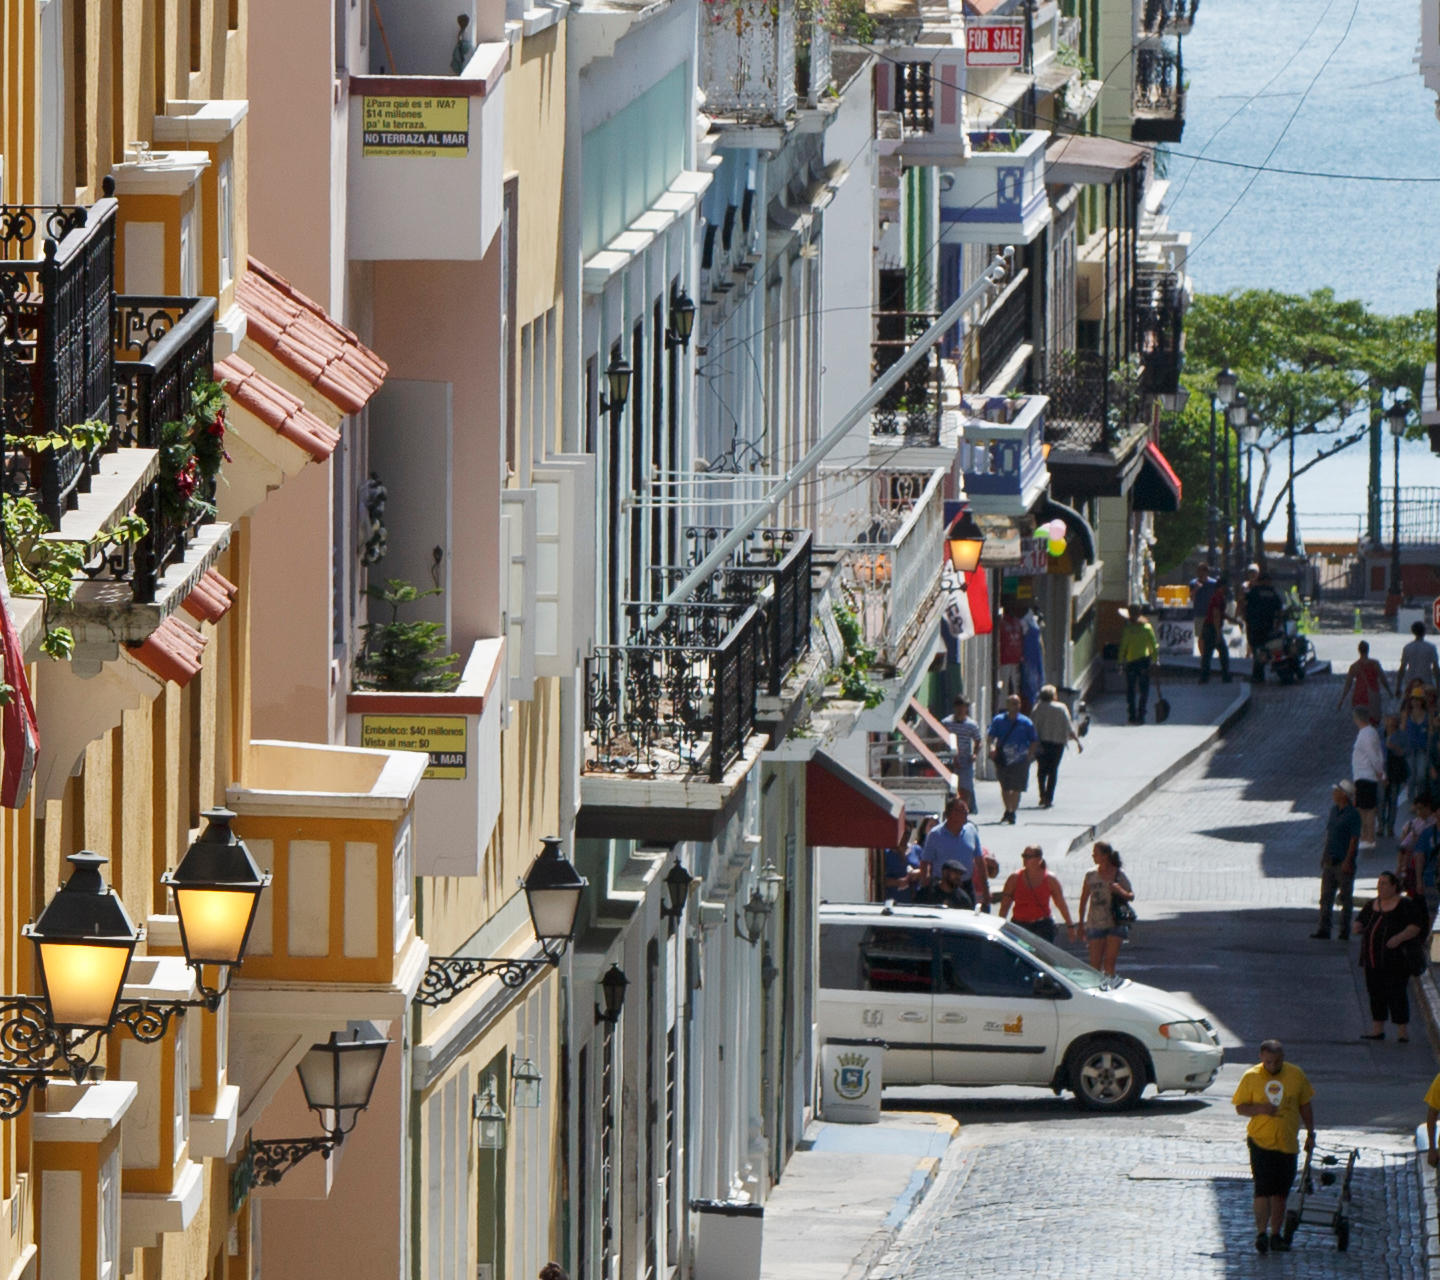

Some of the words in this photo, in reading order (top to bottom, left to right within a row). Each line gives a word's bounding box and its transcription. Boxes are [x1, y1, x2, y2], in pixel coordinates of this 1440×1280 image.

[968, 29, 989, 50] FOR
[993, 29, 1020, 50] SALE
[411, 100, 422, 108] es
[436, 100, 456, 109] IVA?
[366, 108, 382, 118] $14
[385, 110, 422, 118] millones
[383, 120, 390, 128] la
[365, 133, 379, 144] NO
[382, 133, 425, 144] TERRAZA
[427, 133, 439, 144] AL
[442, 133, 465, 144] MAR
[365, 725, 408, 735] Embeleco:
[410, 726, 426, 736] $40
[428, 727, 464, 736] millones
[365, 738, 386, 747] Vista
[388, 738, 396, 747] al
[398, 740, 417, 748] mar:
[419, 739, 430, 748] $0
[441, 754, 463, 765] MAR
